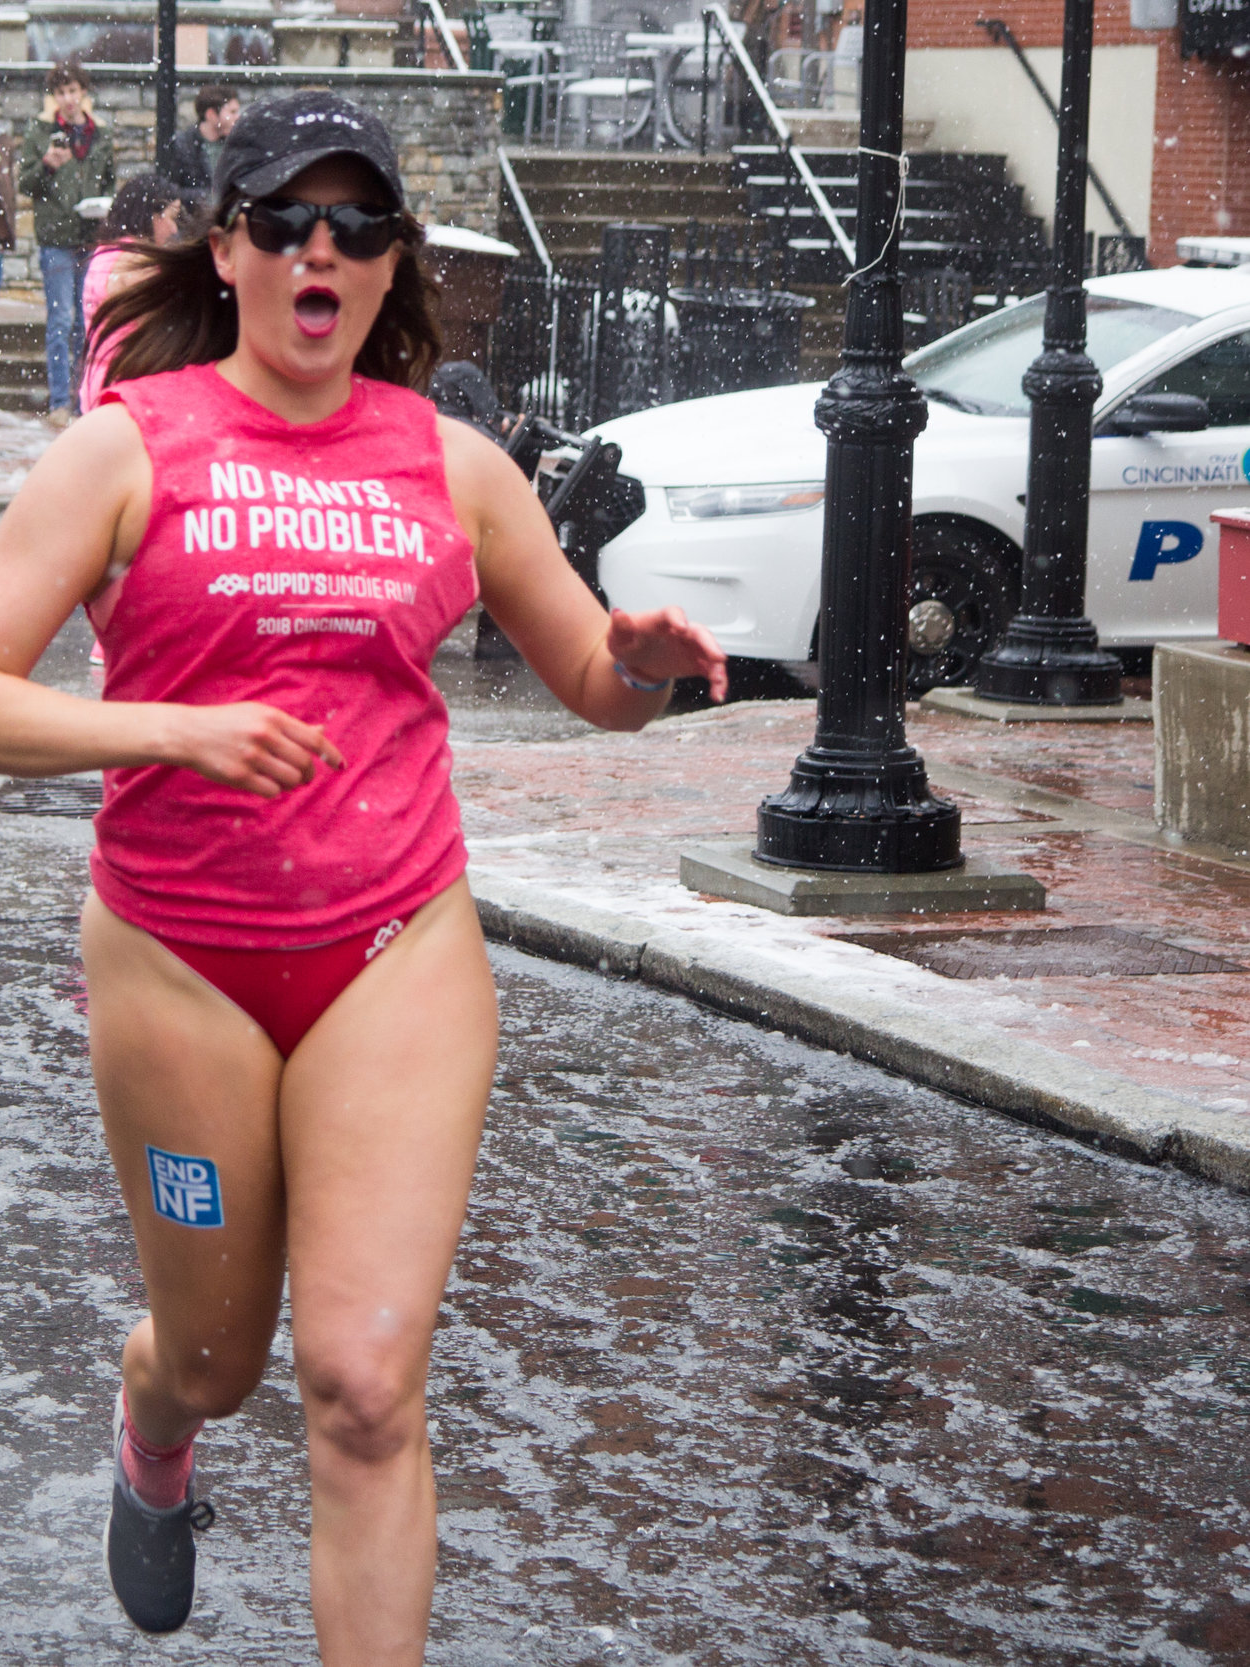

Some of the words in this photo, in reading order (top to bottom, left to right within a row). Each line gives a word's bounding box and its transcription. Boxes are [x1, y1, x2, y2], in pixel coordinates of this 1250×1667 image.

[210, 461, 265, 500] NO
[270, 470, 402, 511] PANTS.
[1122, 465, 1239, 485] CINCINNATI
[184, 506, 237, 554] NO
[248, 506, 435, 565] PROBLEM.
[1128, 520, 1205, 582] P
[256, 617, 290, 636] 2018
[294, 617, 377, 637] CINCINNATI
[152, 1153, 208, 1184] END
[157, 1181, 212, 1222] NF
